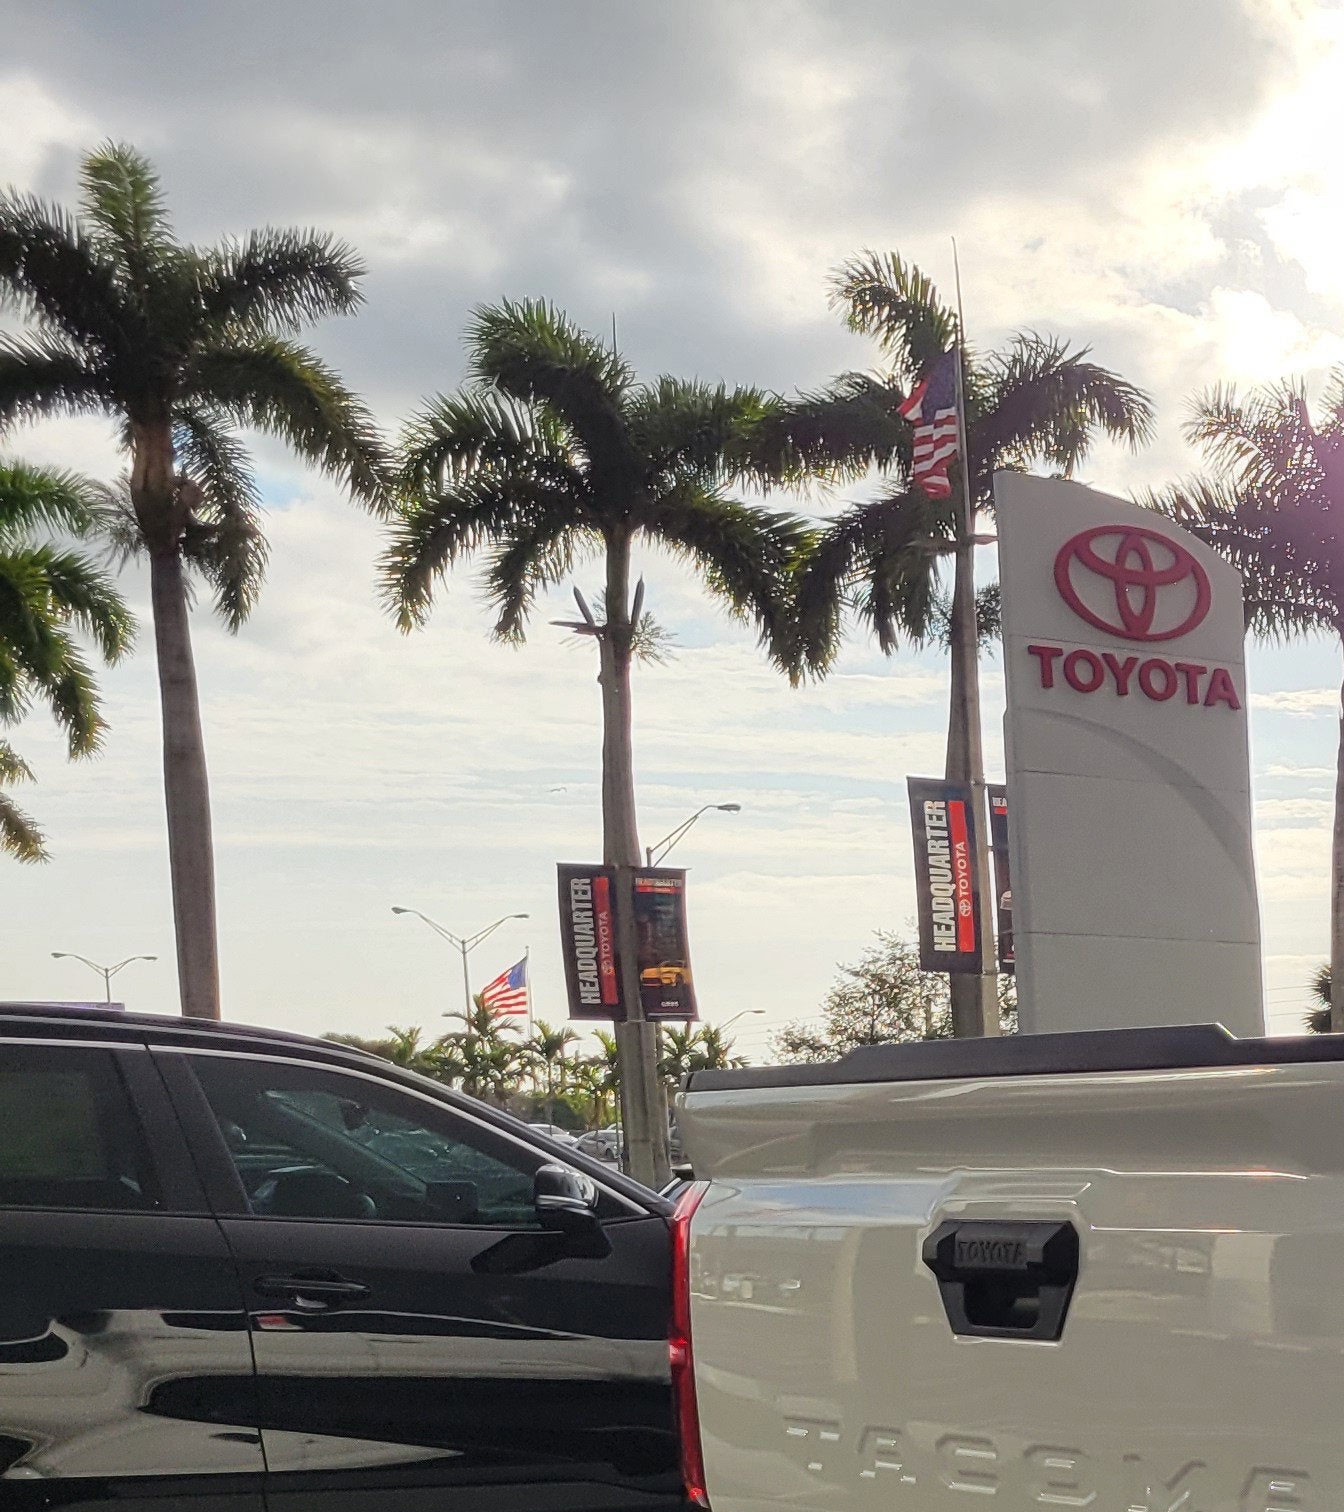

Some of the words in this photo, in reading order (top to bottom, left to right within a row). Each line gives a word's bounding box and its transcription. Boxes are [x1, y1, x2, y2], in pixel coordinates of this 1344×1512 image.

[1027, 644, 1241, 711] TOYOTA
[923, 800, 957, 952] HEADQUARTER
[955, 841, 970, 898] TOYOTA
[570, 877, 602, 1005] HEADQUARTER
[599, 911, 613, 962] TOYOTA
[958, 1240, 1024, 1266] TOYOTA
